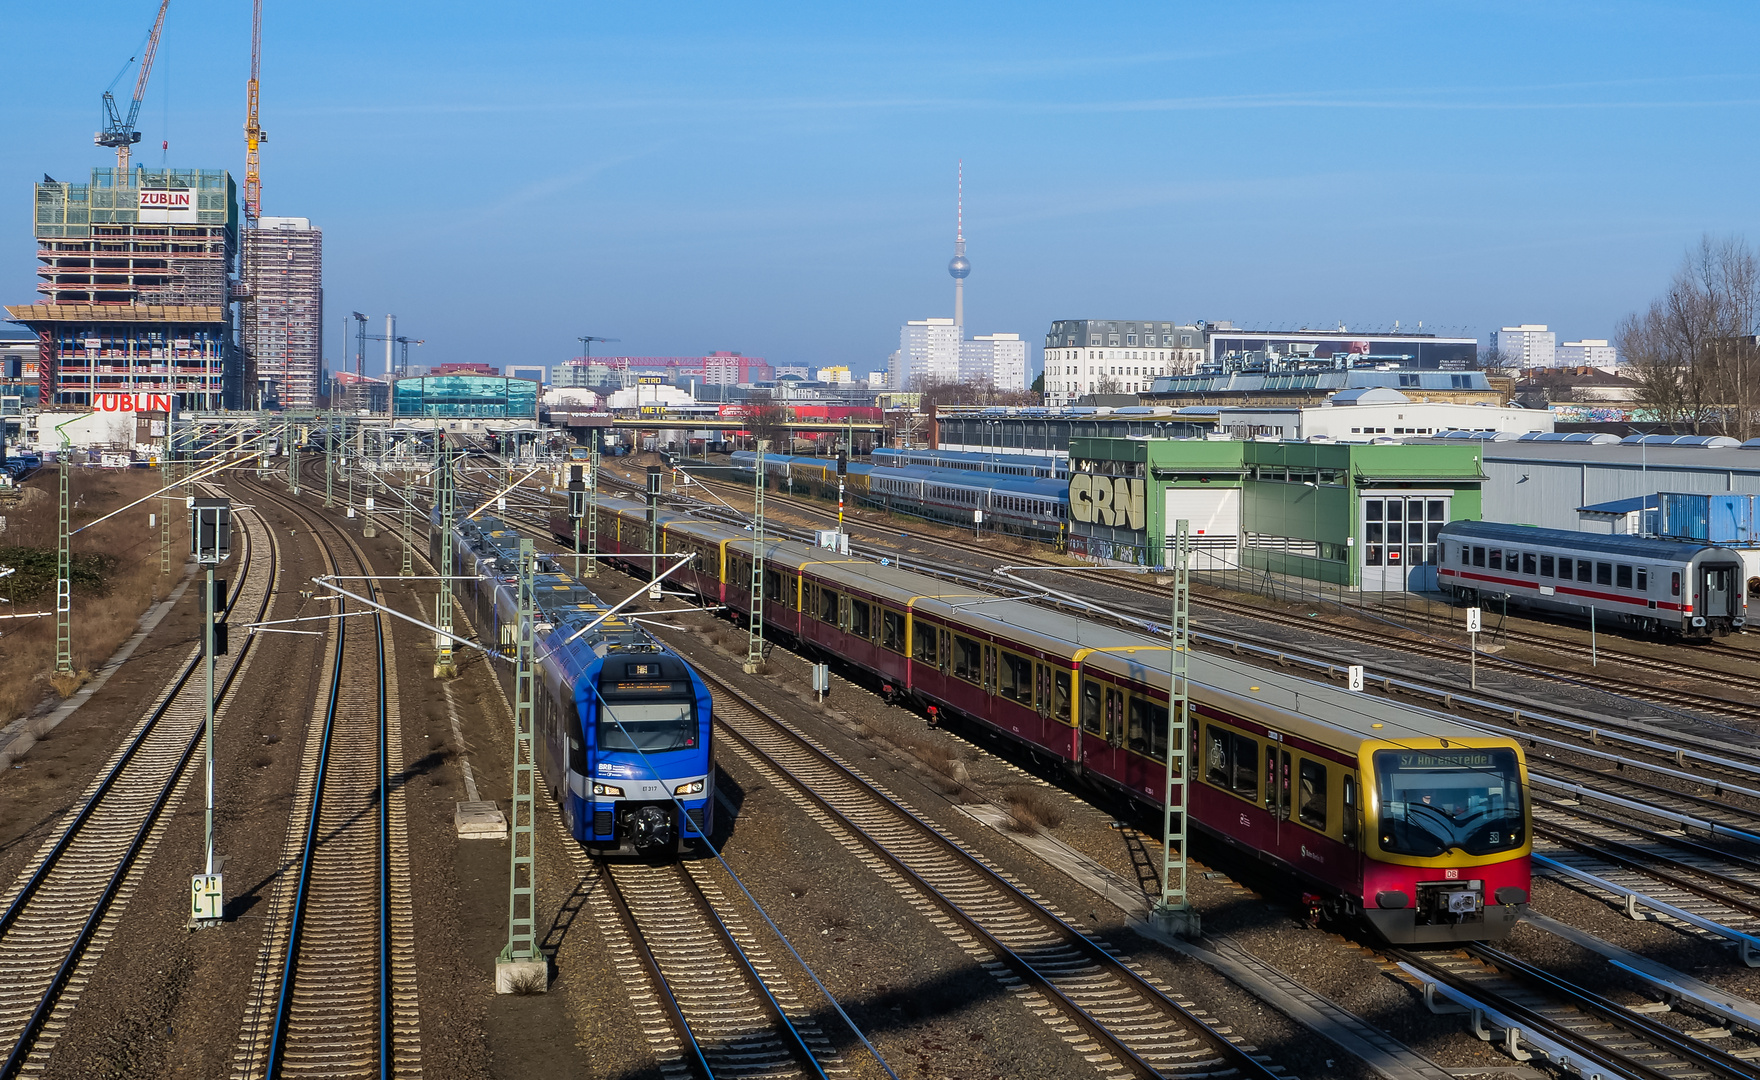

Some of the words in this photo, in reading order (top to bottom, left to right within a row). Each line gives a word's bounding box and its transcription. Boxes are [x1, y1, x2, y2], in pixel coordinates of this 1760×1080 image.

[140, 193, 190, 205] ZÜBLIN
[92, 393, 171, 412] ZÜBLIN
[598, 763, 613, 771] BRB
[1446, 870, 1458, 879] DB
